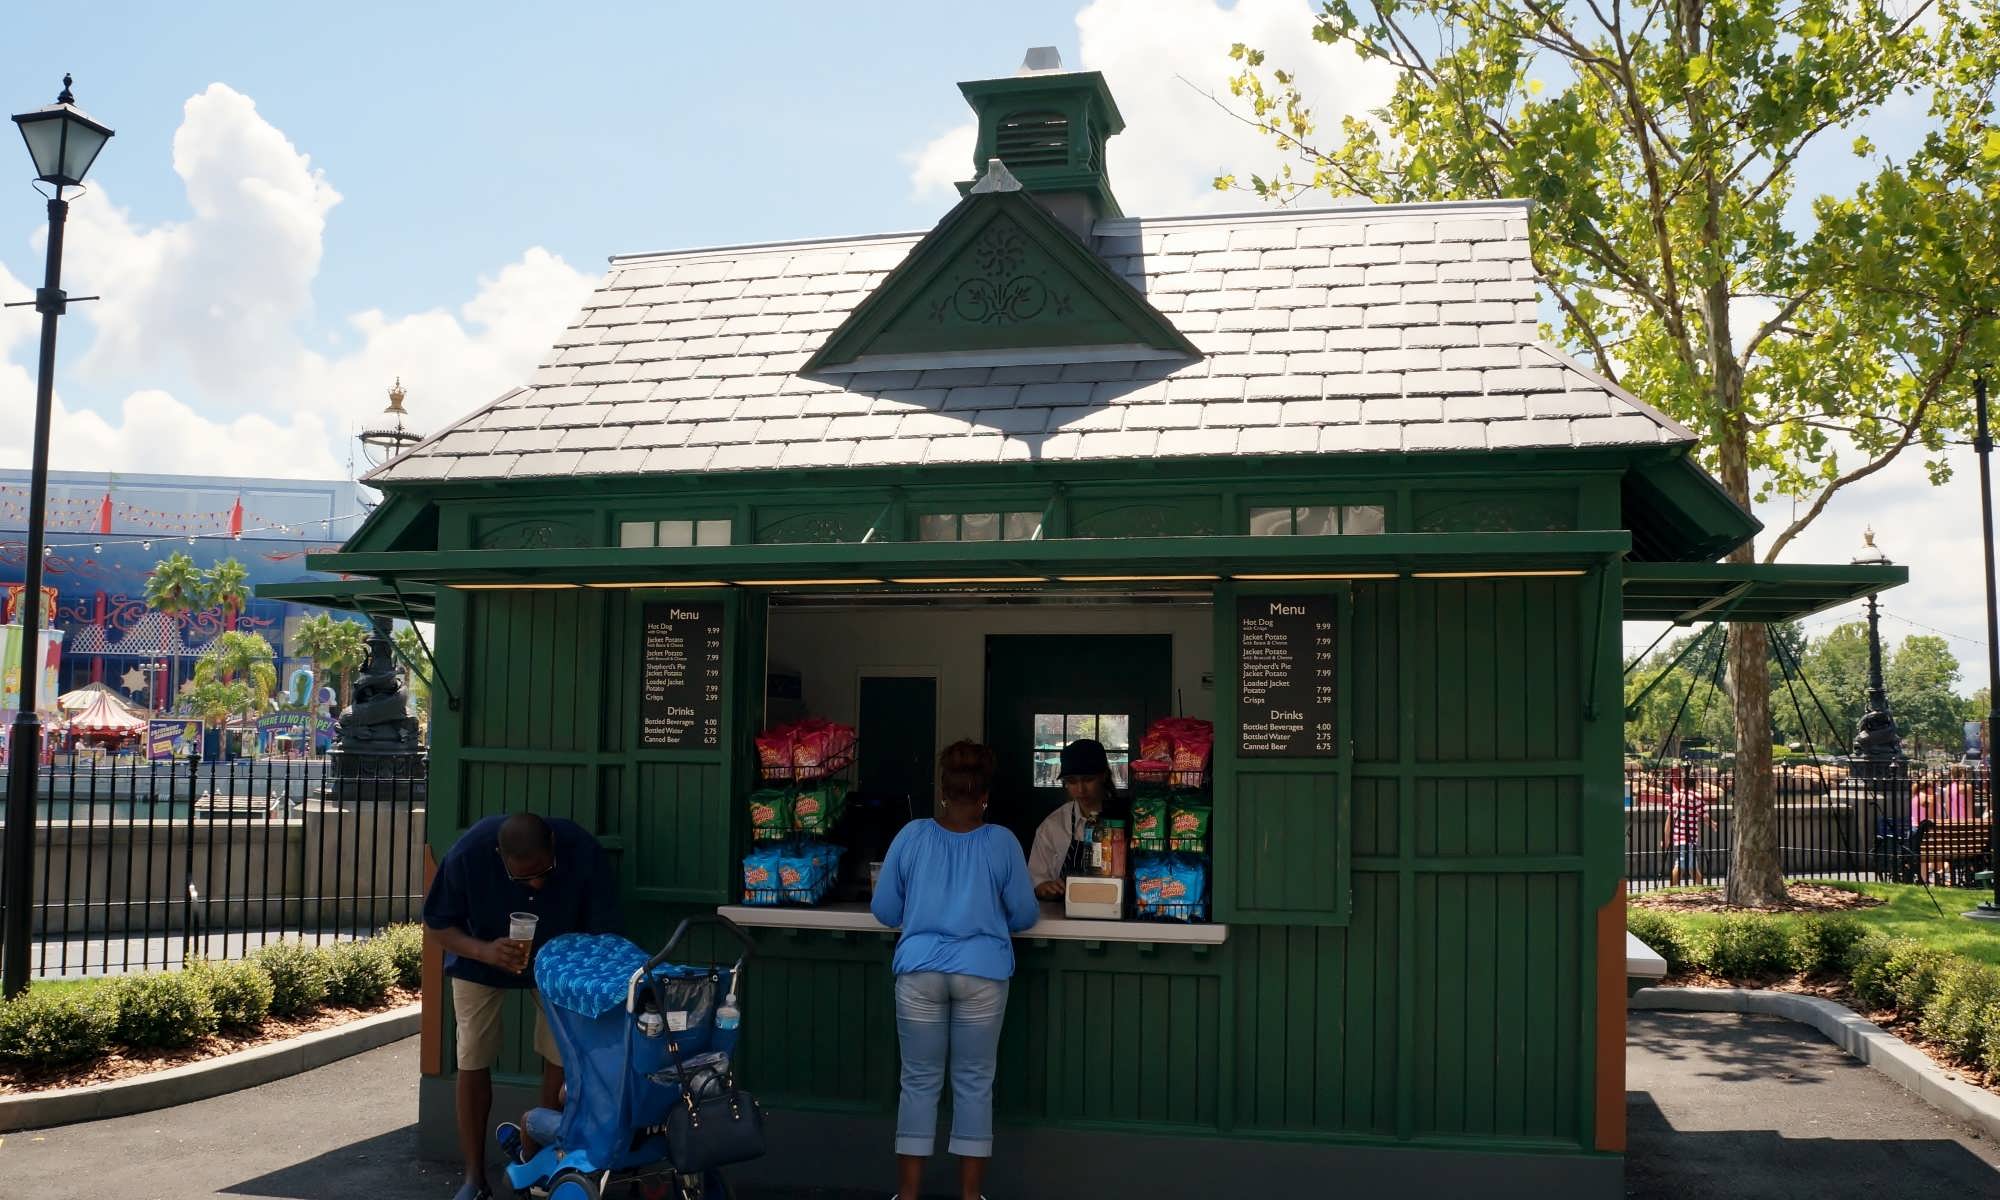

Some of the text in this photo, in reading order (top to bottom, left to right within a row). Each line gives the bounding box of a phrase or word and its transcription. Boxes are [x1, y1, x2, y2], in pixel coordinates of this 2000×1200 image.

[1270, 603, 1305, 615] Menu
[670, 609, 699, 620] Menu
[661, 623, 672, 631] Dog
[1259, 619, 1273, 627] Dog
[1243, 663, 1279, 671] Shepherd's
[1243, 670, 1262, 678] Jacket
[668, 707, 694, 715] Drinks
[1271, 711, 1303, 720] Drinks
[259, 716, 277, 727] THERE
[280, 715, 285, 723] IS
[288, 715, 299, 723] NO
[1270, 724, 1303, 732] Beverages
